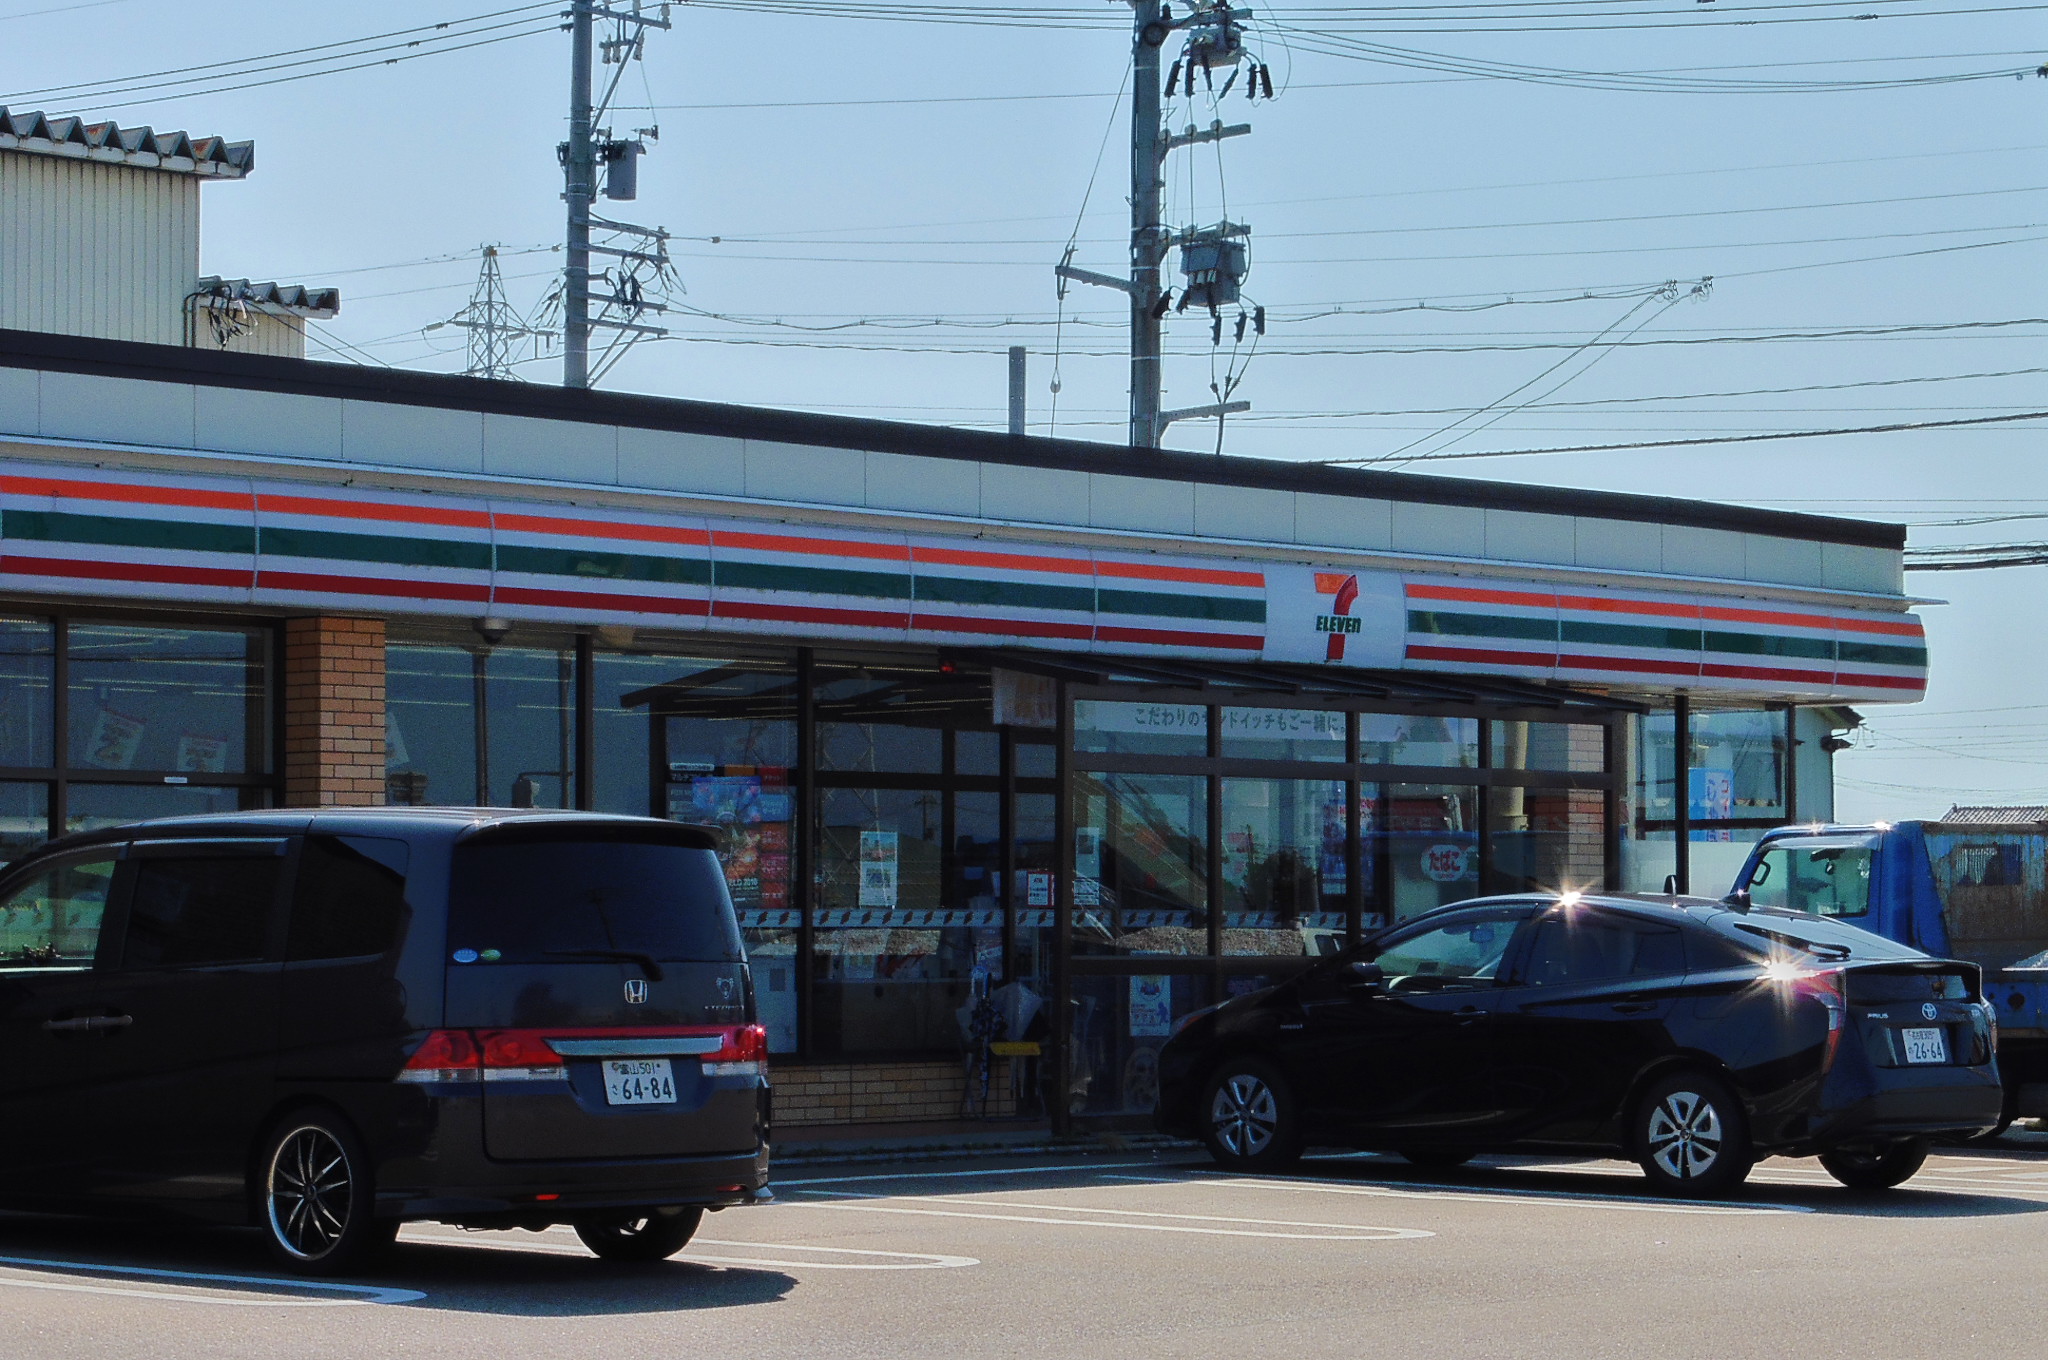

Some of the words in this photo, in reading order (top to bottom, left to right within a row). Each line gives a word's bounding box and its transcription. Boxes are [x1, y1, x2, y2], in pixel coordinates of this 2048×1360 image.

[1134, 706, 1345, 733] こだわりのドイッチもご一緒に。
[1428, 848, 1461, 872] たばこ
[622, 1077, 672, 1100] 64-84
